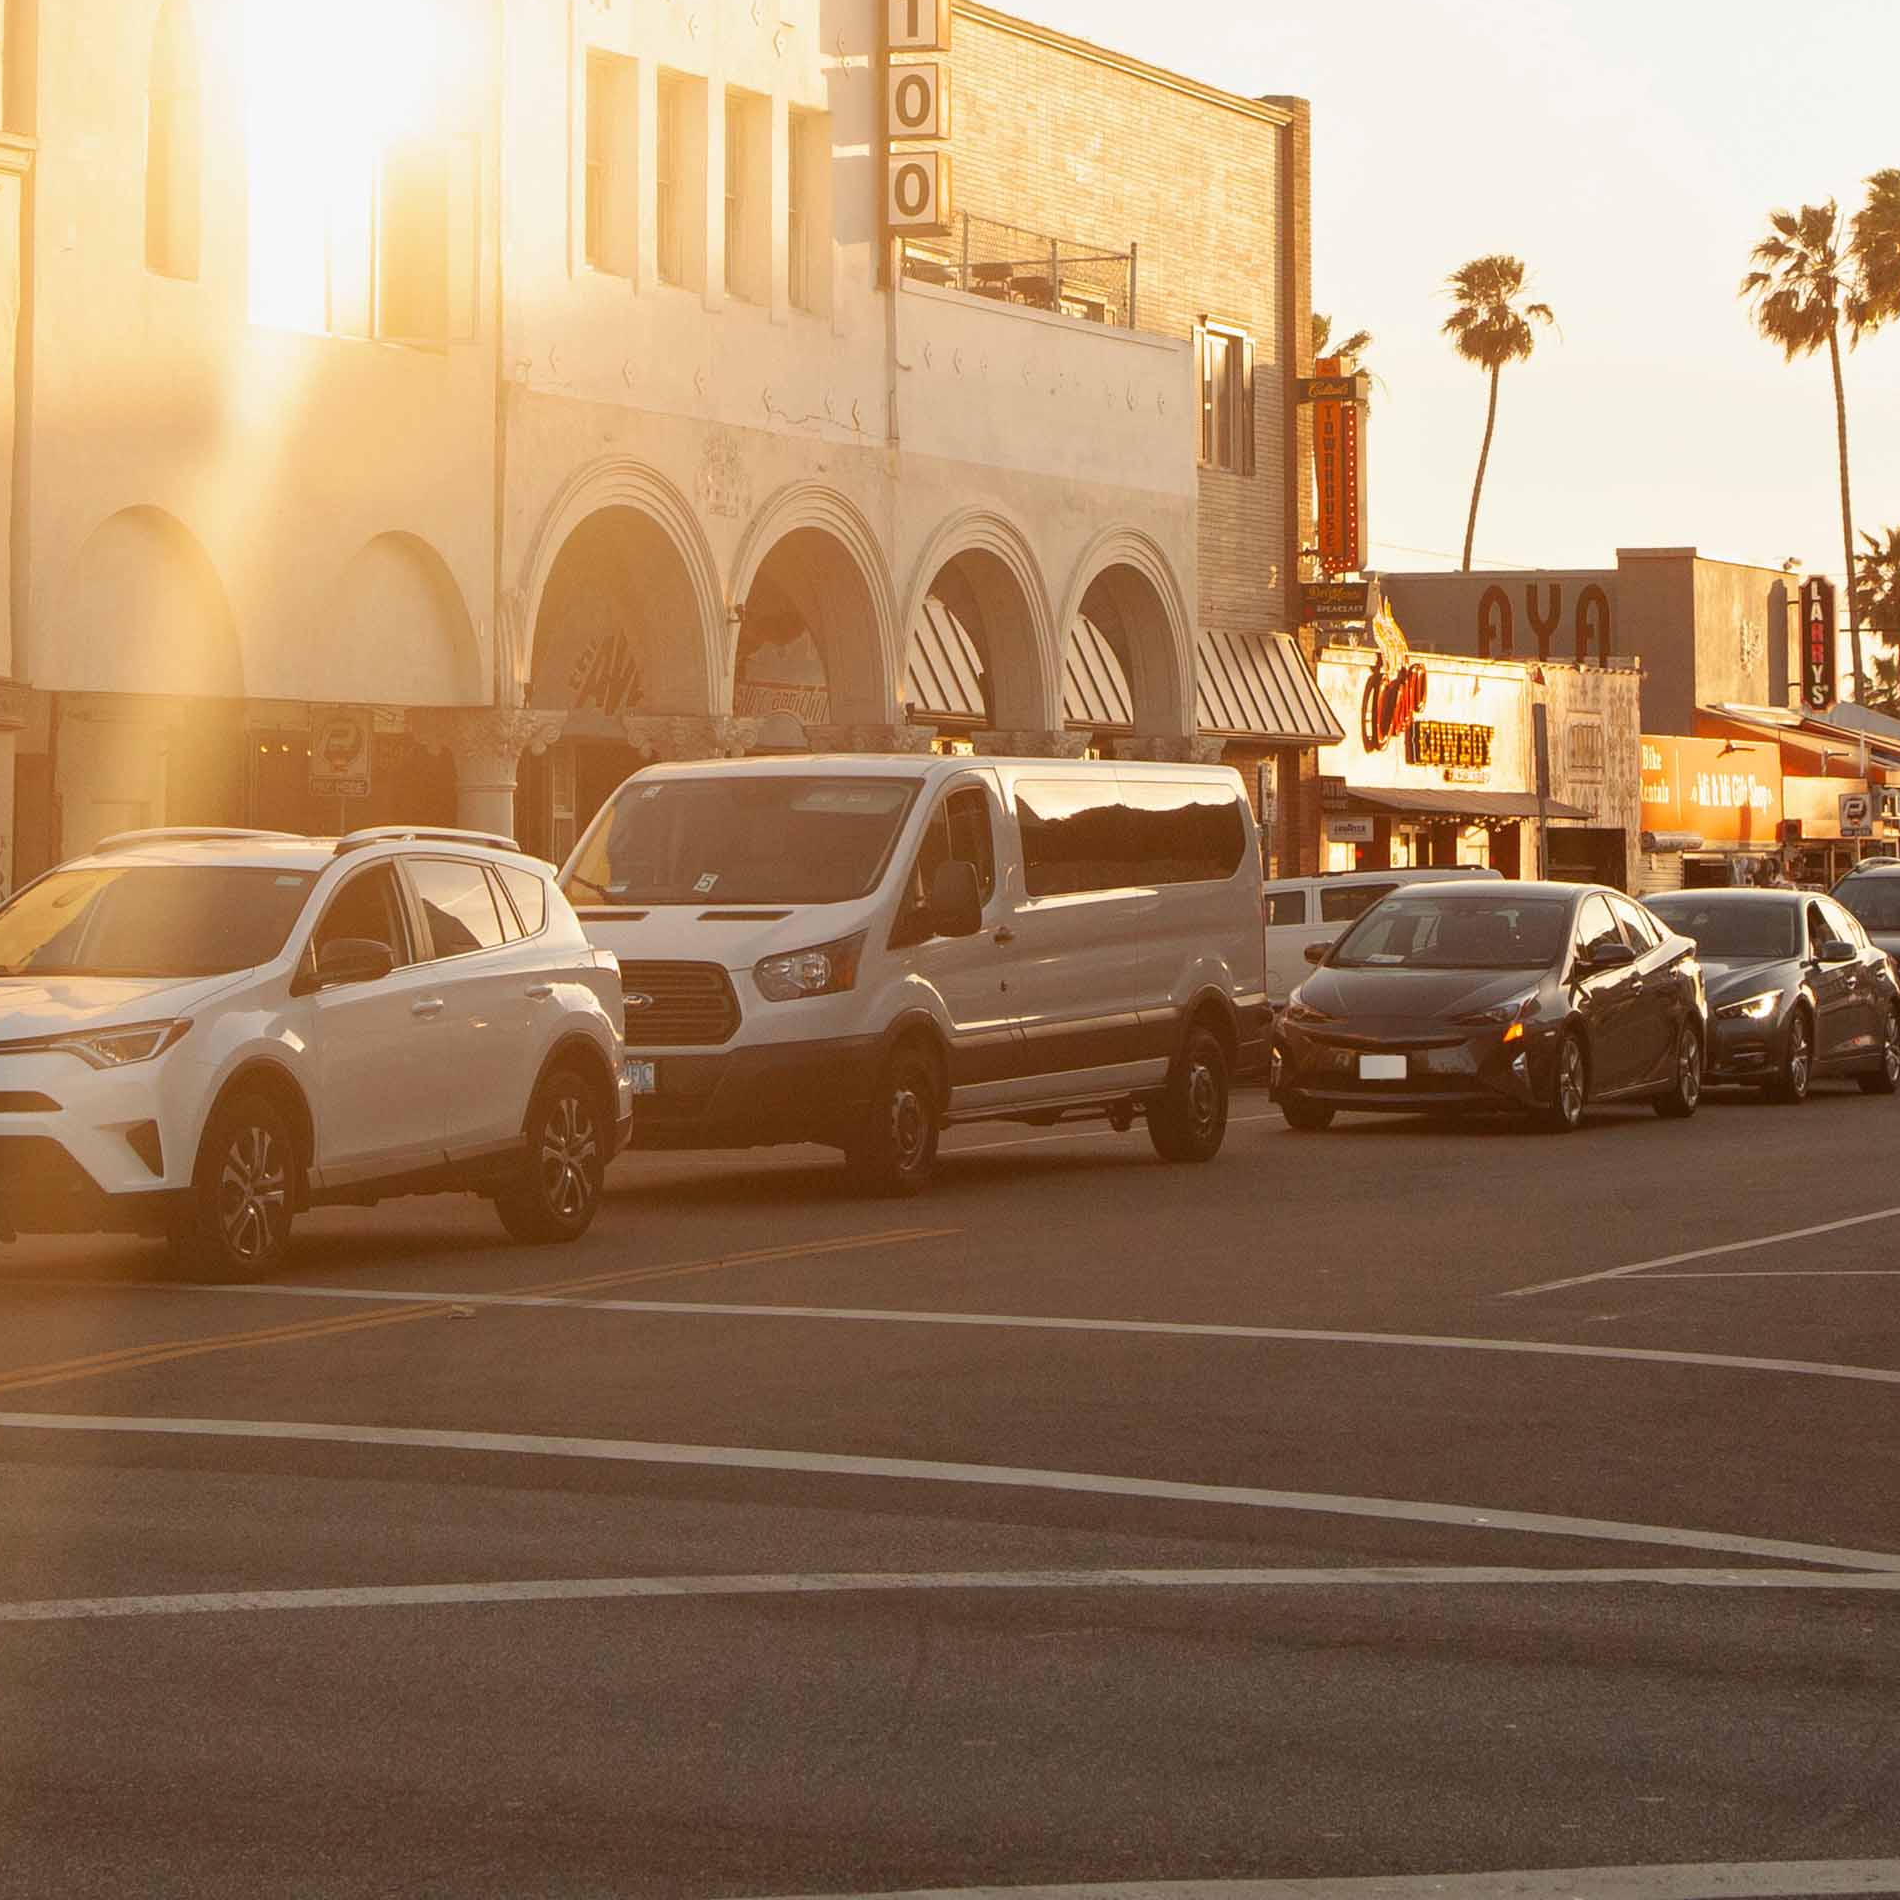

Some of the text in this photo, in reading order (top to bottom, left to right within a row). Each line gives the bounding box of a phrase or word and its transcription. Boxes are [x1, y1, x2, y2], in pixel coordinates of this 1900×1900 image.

[1477, 583, 1613, 666] AYA
[1809, 581, 1829, 706] LARRY'S
[1642, 745, 1662, 771] Bike
